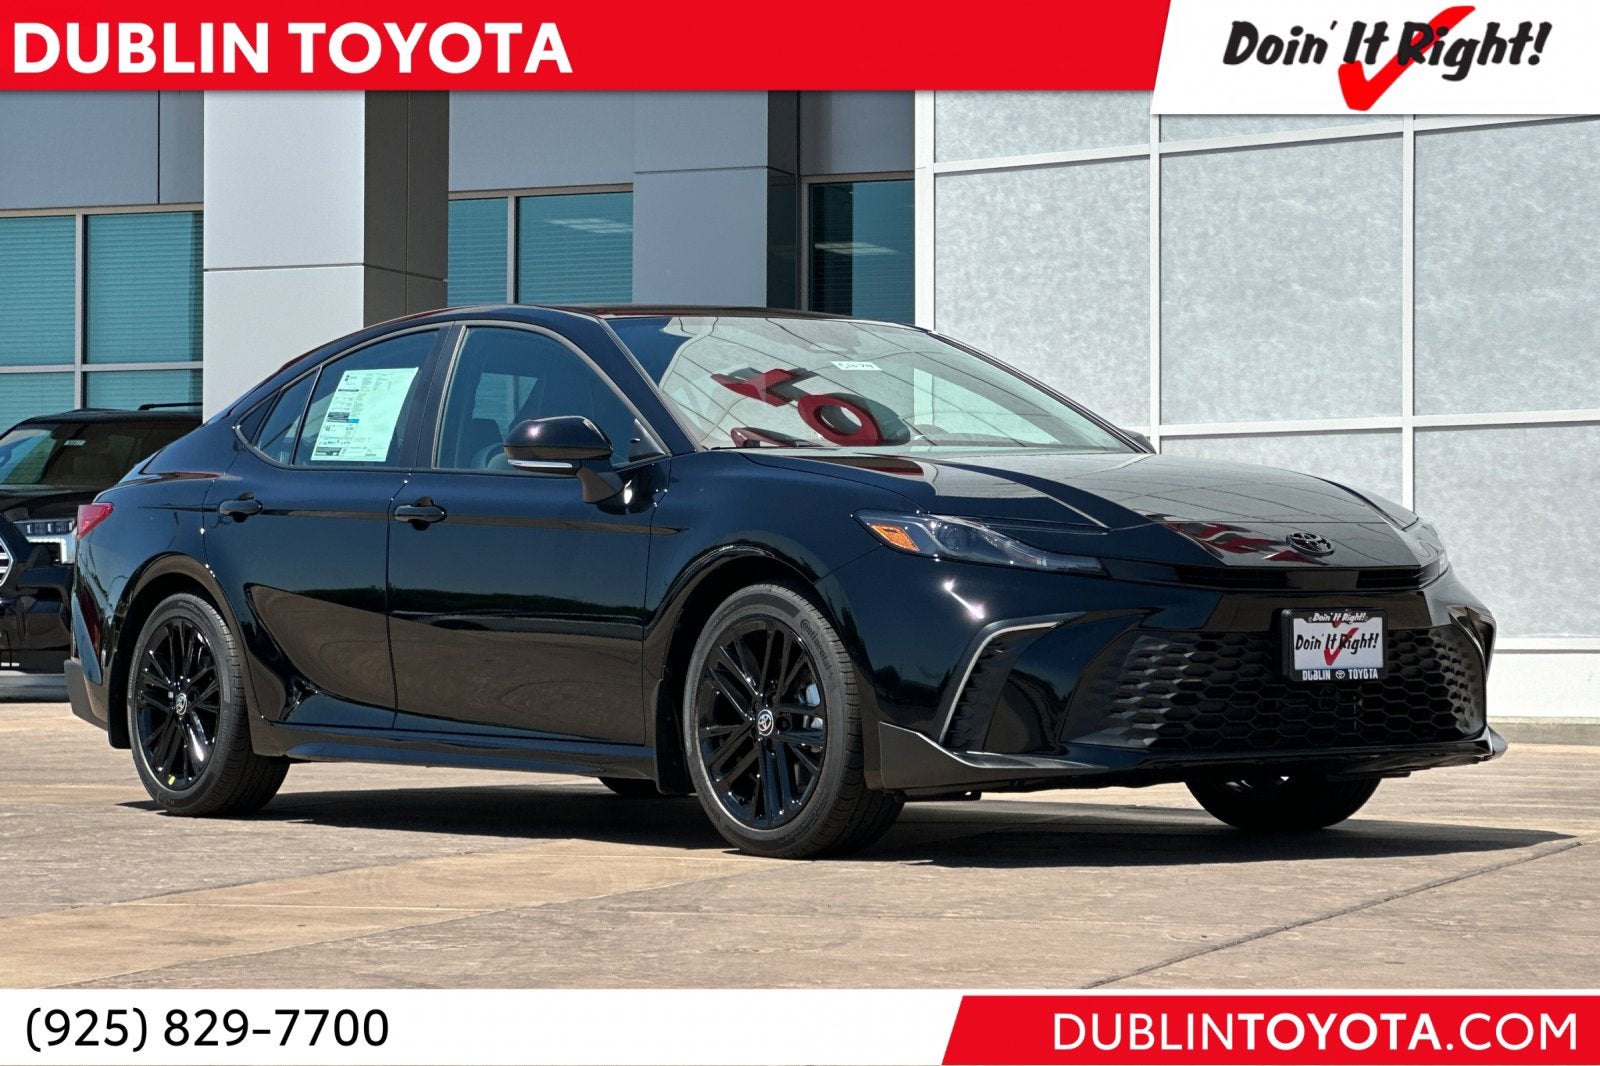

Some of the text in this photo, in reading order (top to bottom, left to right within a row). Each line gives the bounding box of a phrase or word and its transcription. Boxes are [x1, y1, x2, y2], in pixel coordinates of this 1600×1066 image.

[1333, 612, 1342, 622] It
[1342, 612, 1367, 624] Right!
[1295, 632, 1380, 655] Doin' It Right!
[1302, 668, 1379, 681] DUBLIN TOYOTA
